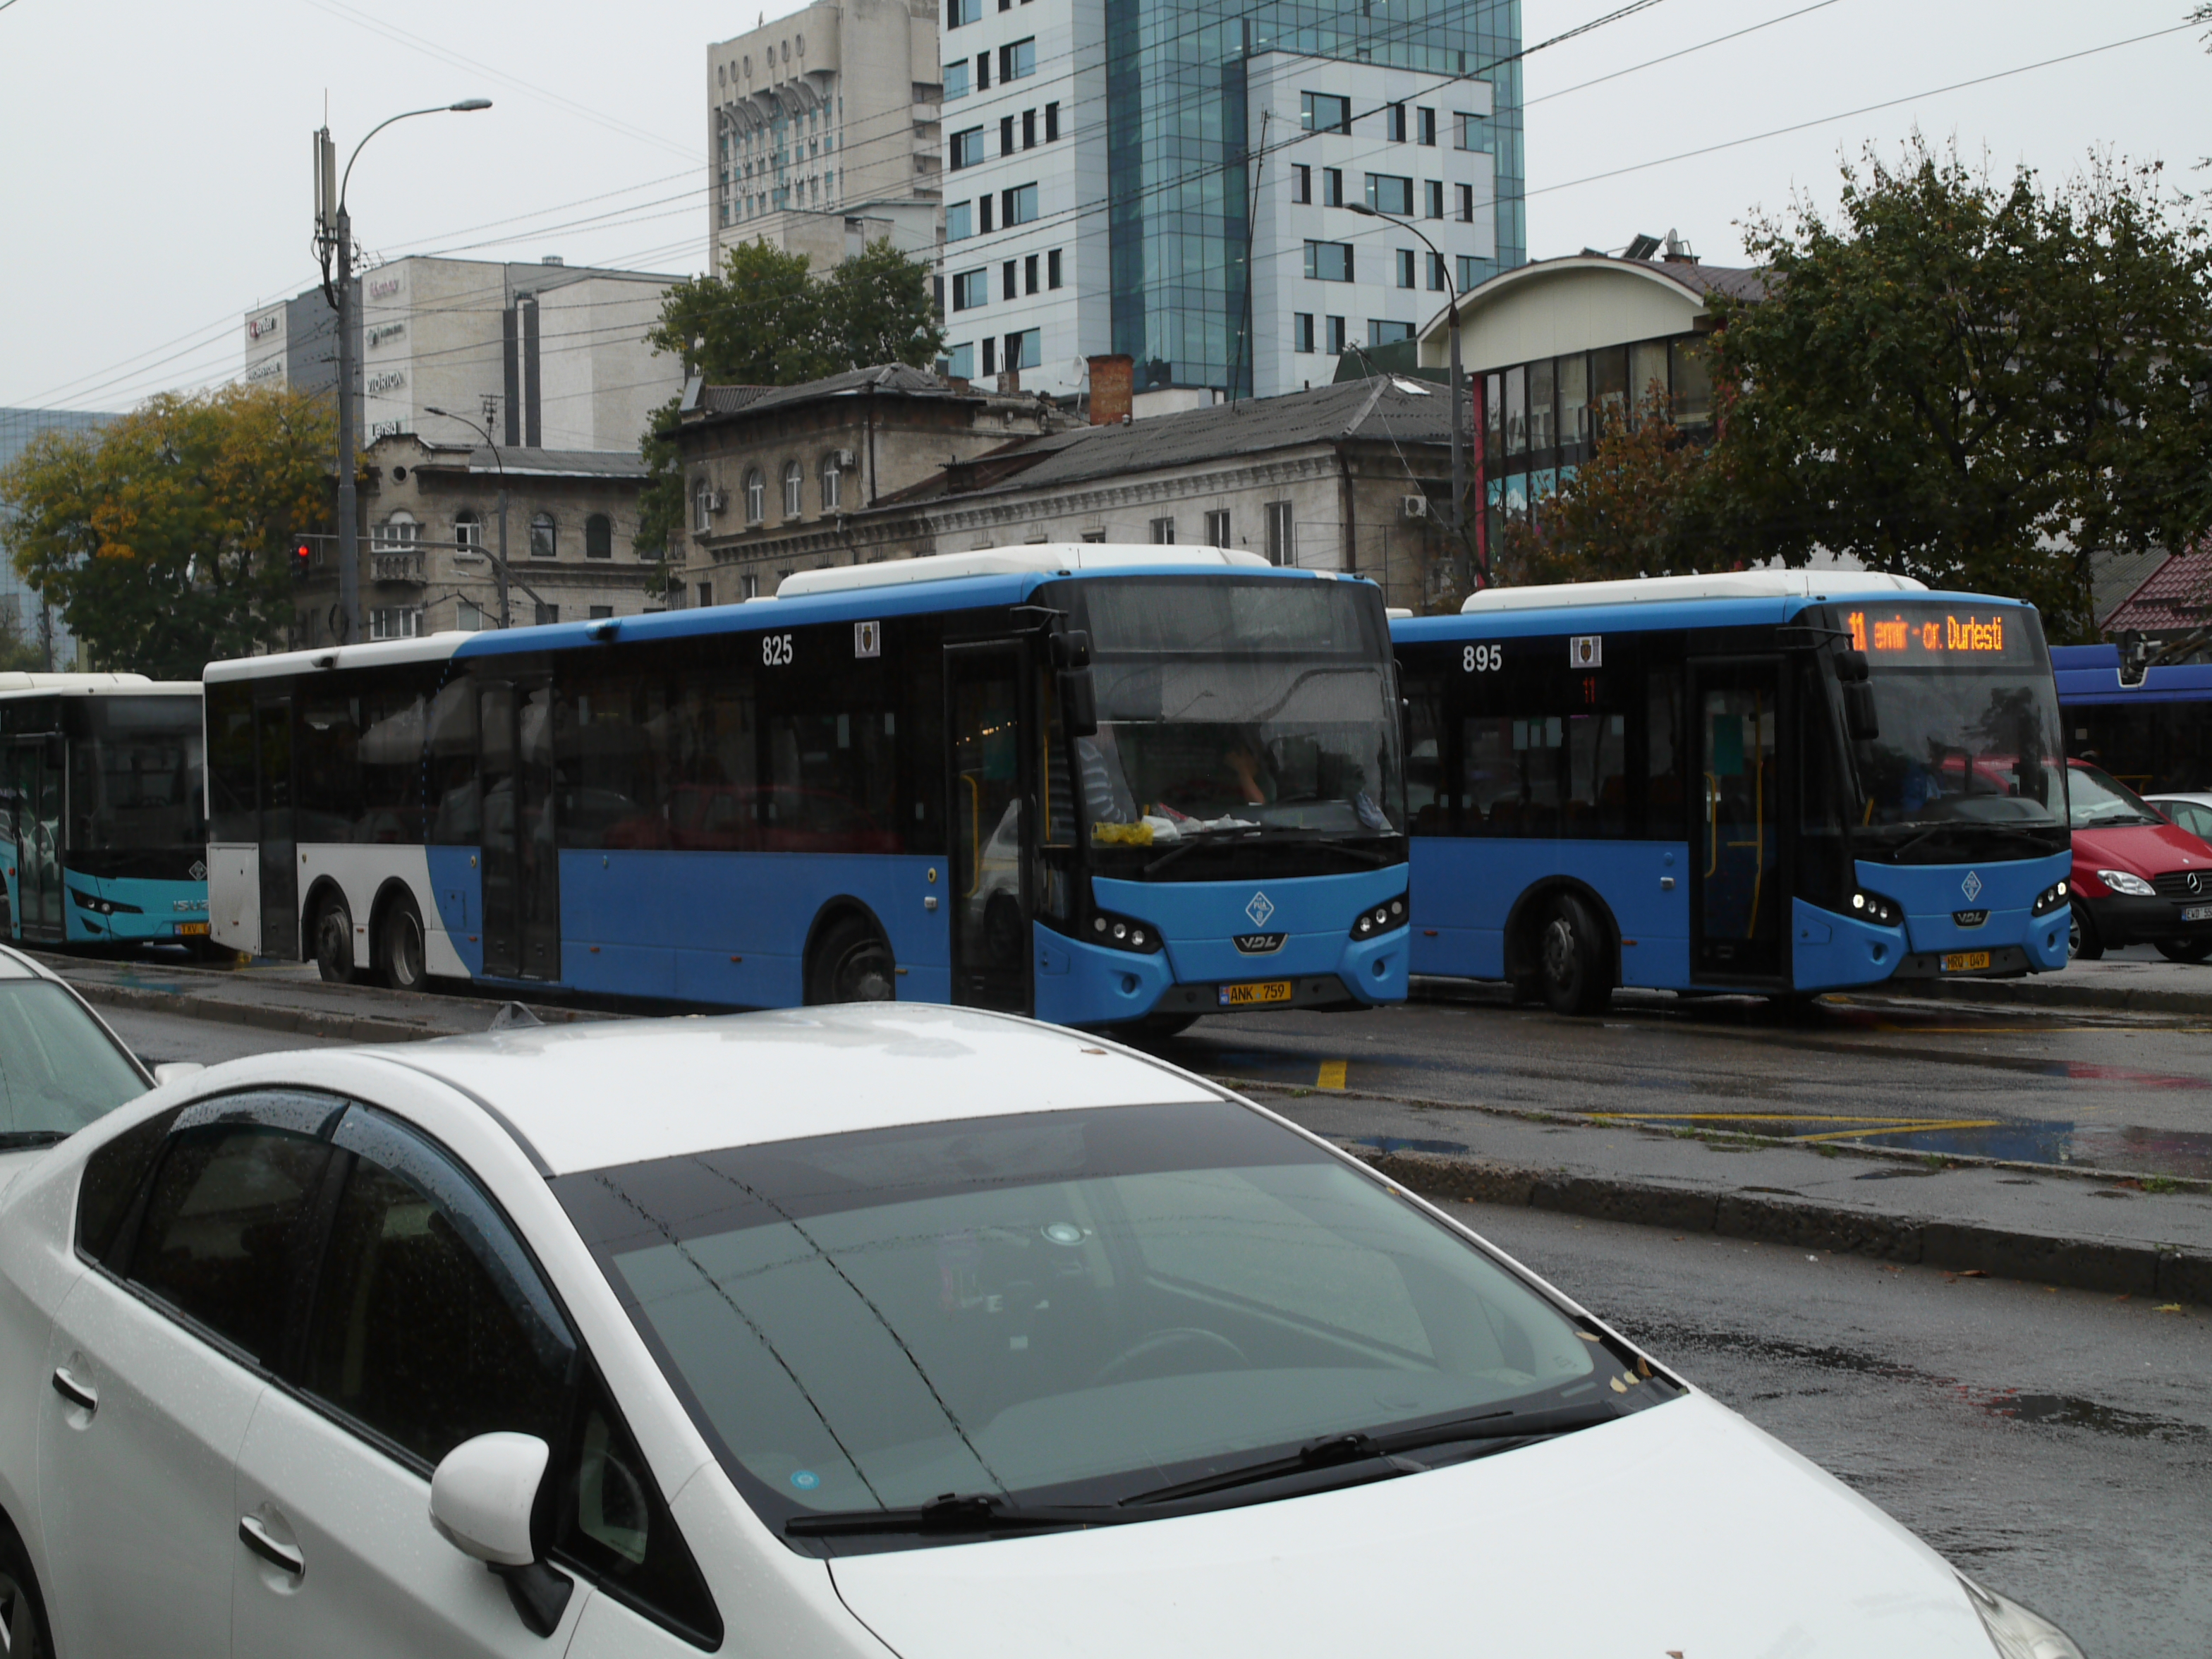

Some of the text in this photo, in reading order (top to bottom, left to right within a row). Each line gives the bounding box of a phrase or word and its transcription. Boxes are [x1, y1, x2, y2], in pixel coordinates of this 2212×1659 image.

[1947, 615, 2003, 650] Durlesti
[762, 634, 793, 666] 825
[1463, 645, 1502, 672] 895
[1583, 676, 1595, 704] 11
[1957, 911, 1982, 923] VDL
[1241, 935, 1277, 949] VDL
[1231, 986, 1253, 1001] ANK
[1263, 983, 1285, 999] 759
